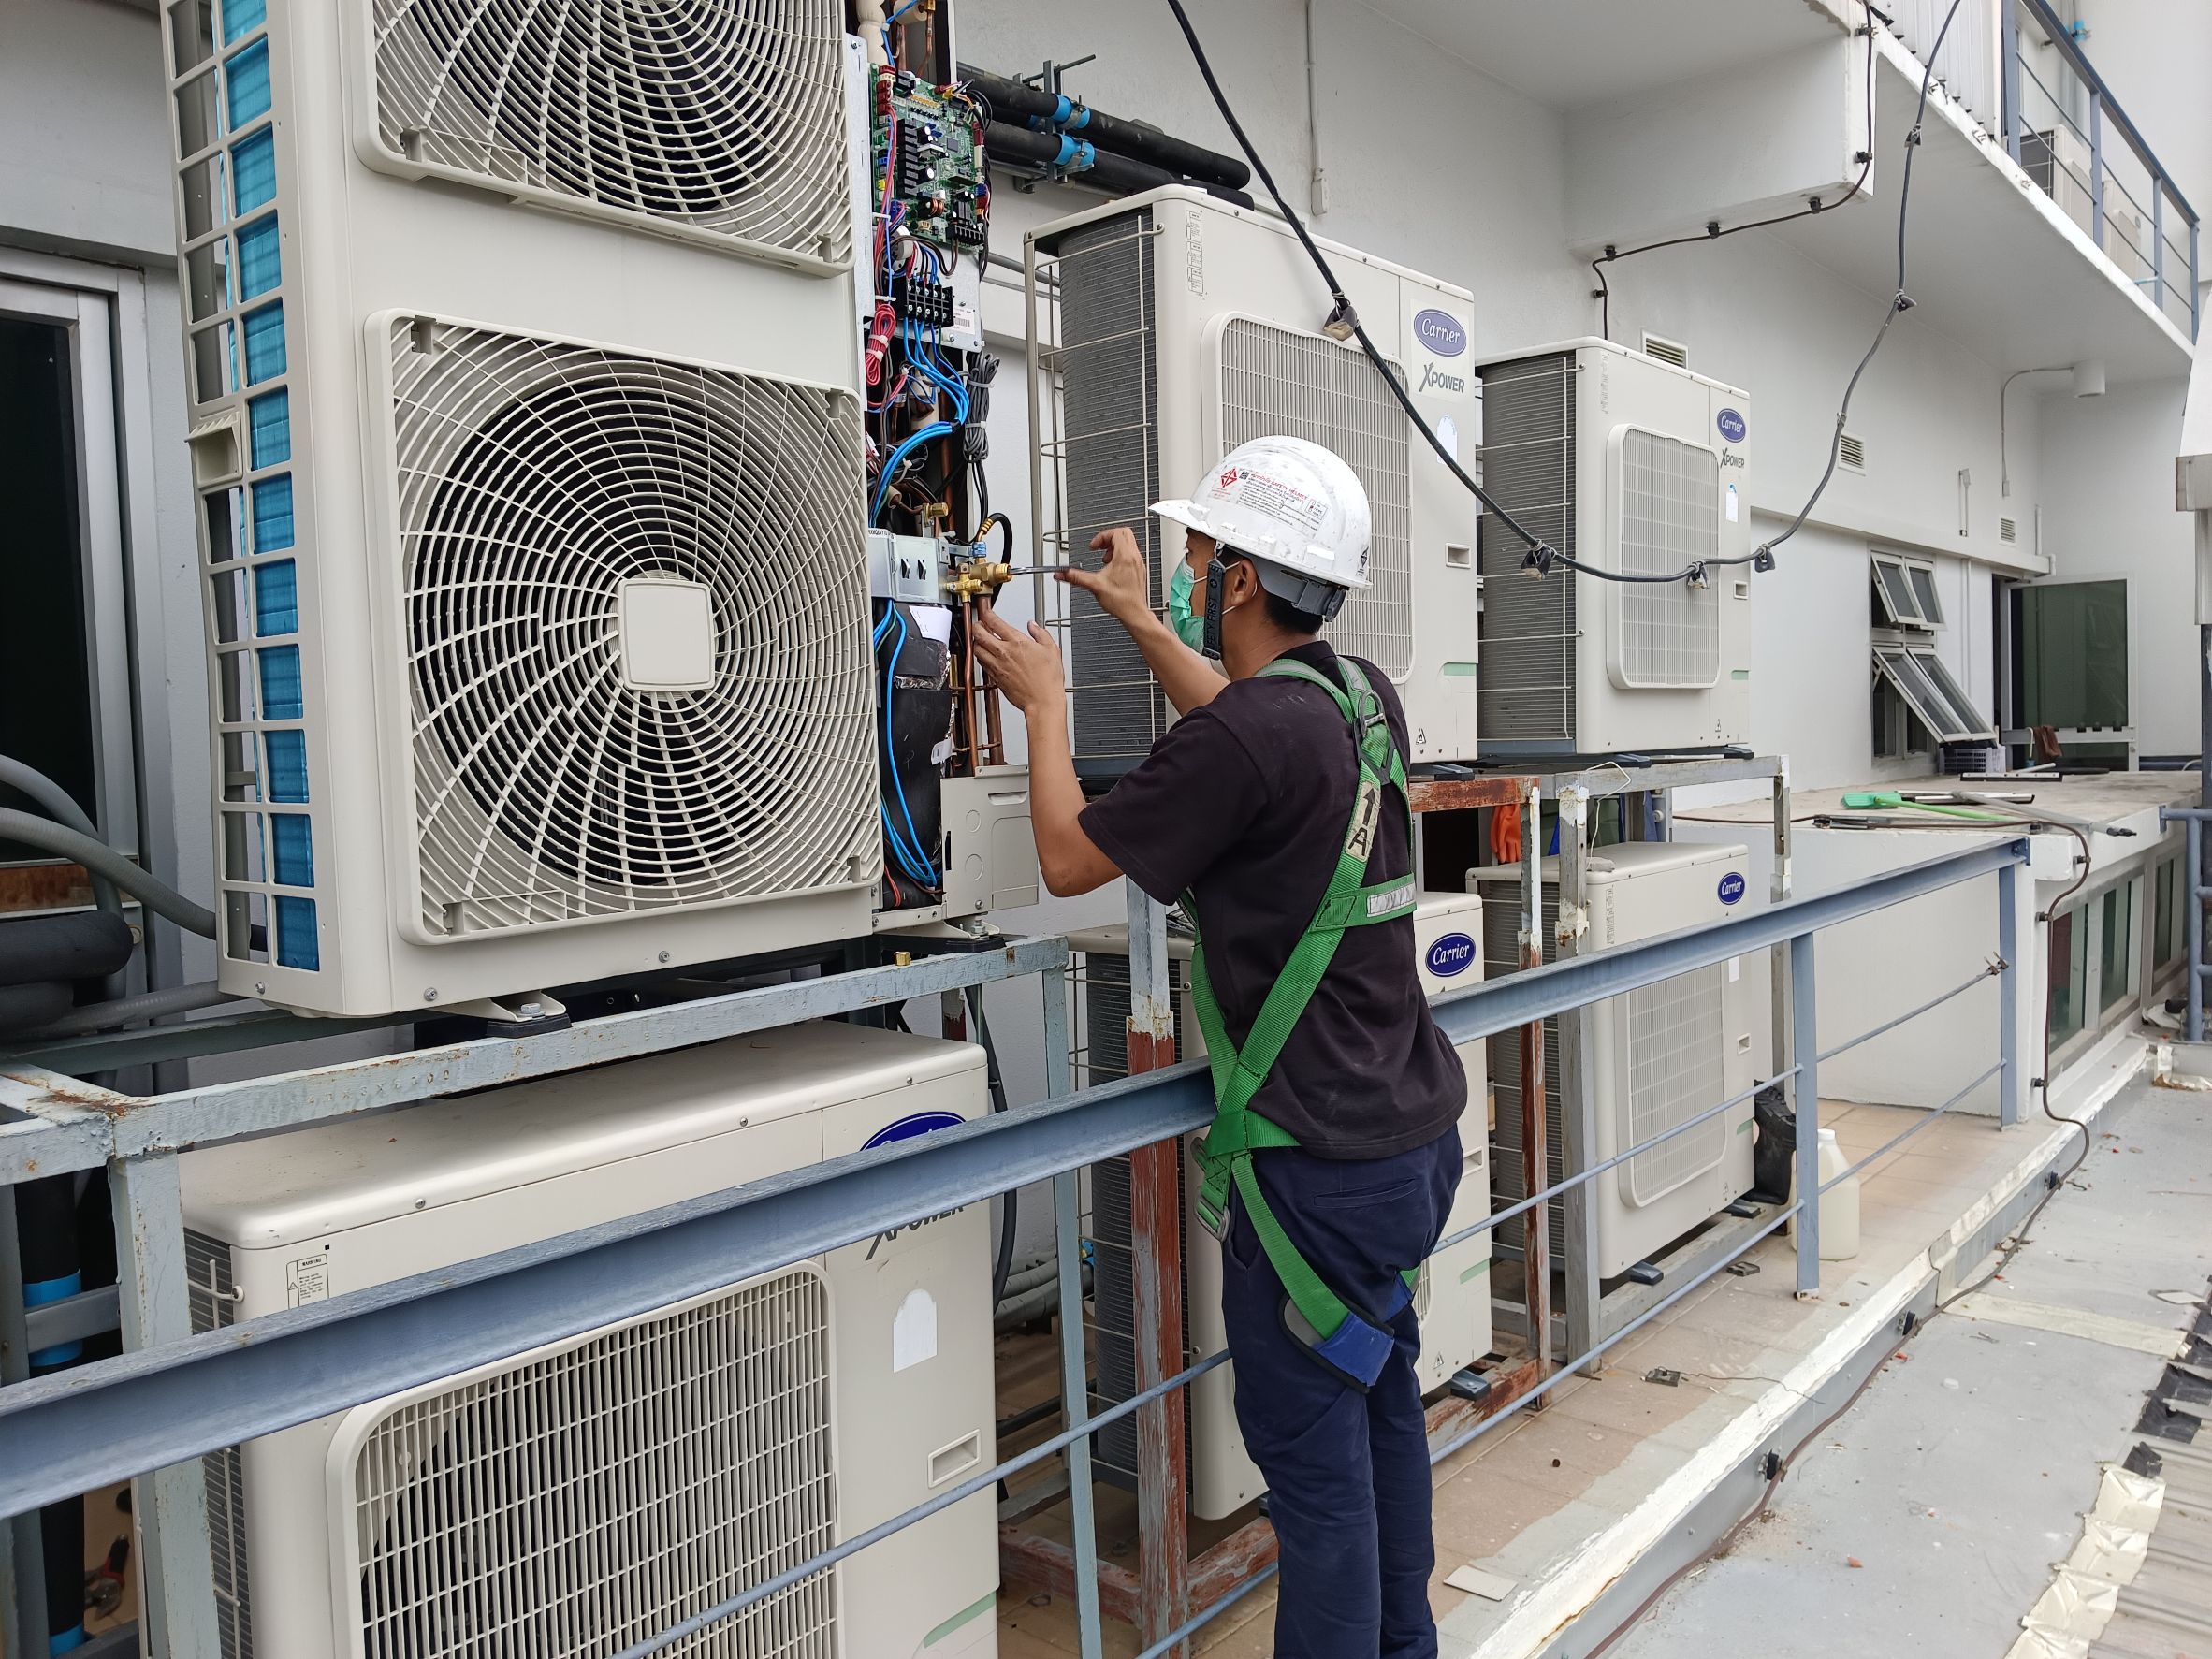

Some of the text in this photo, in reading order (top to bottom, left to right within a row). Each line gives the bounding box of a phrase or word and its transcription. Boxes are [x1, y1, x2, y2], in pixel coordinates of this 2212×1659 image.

[1421, 318, 1461, 343] Carrier
[1419, 361, 1465, 394] XPOWER
[1722, 415, 1742, 433] Carrier
[1206, 596, 1218, 622] FIRST
[1347, 827, 1368, 857] A
[1433, 943, 1470, 966] Carrier
